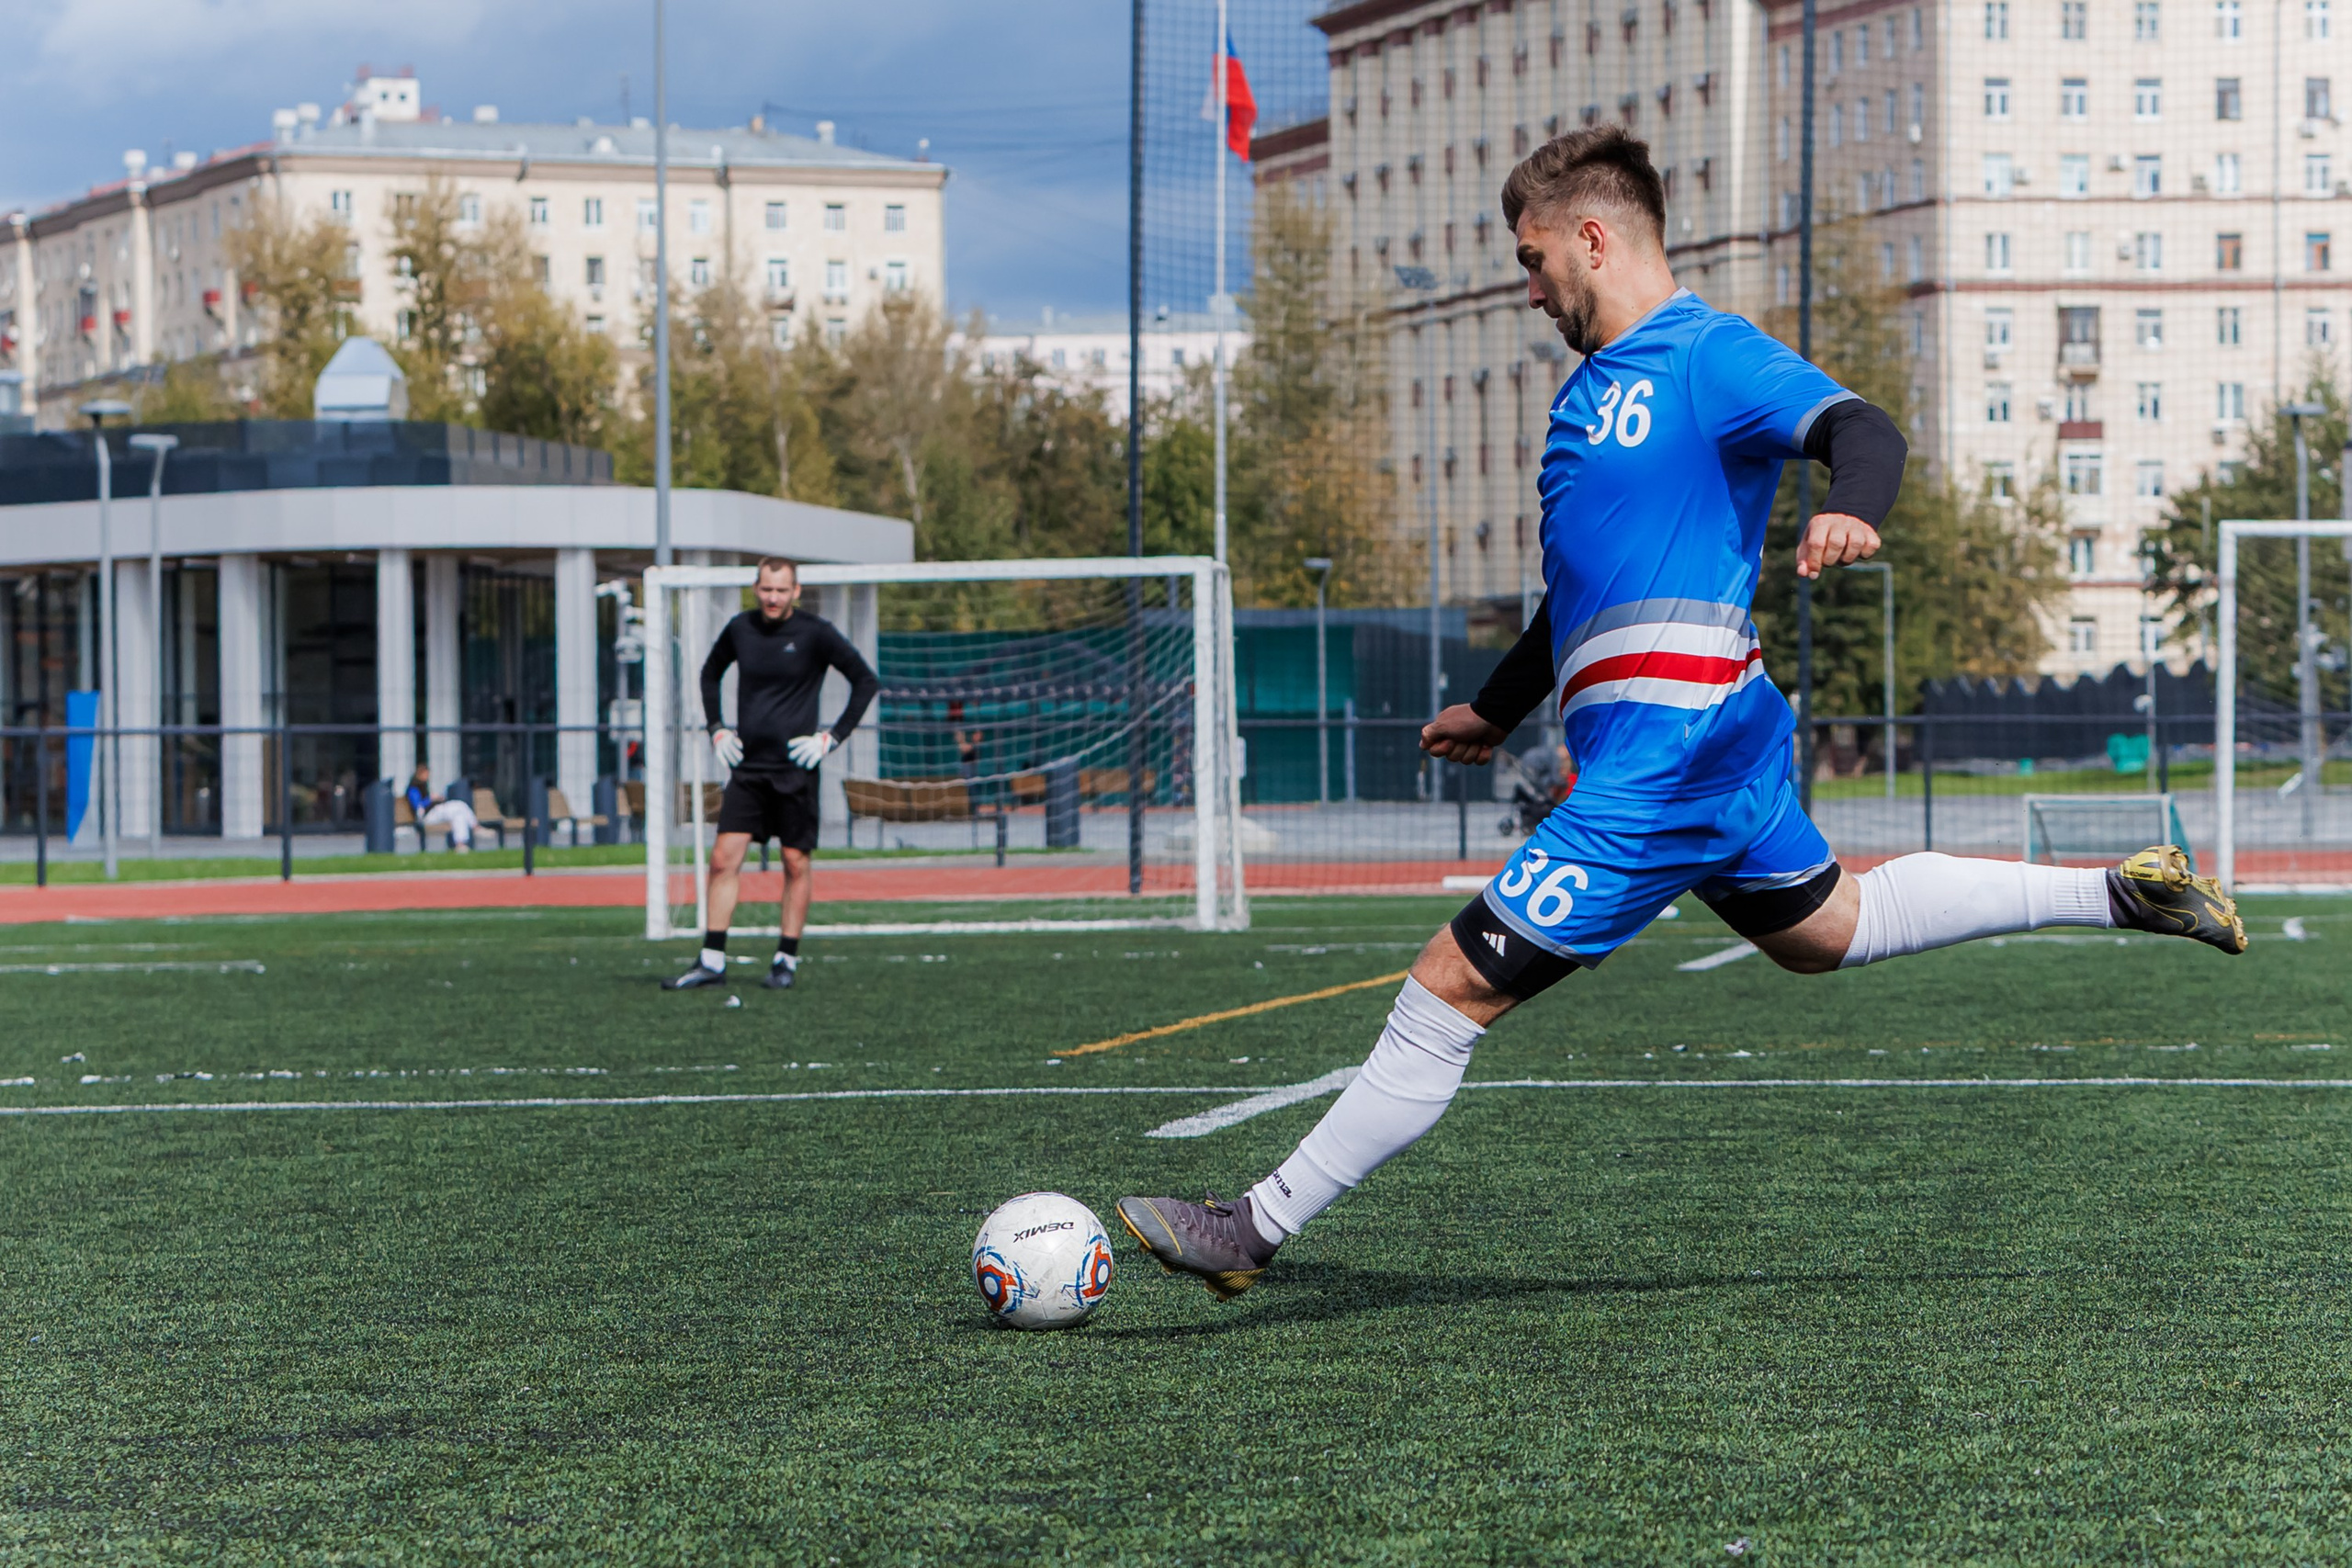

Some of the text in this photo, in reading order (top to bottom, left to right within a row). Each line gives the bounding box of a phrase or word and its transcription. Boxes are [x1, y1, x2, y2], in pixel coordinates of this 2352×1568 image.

[1586, 378, 1654, 447] 36
[1498, 848, 1589, 928] 36
[1272, 1168, 1292, 1198] oma
[1012, 1222, 1074, 1244] DEMIX
